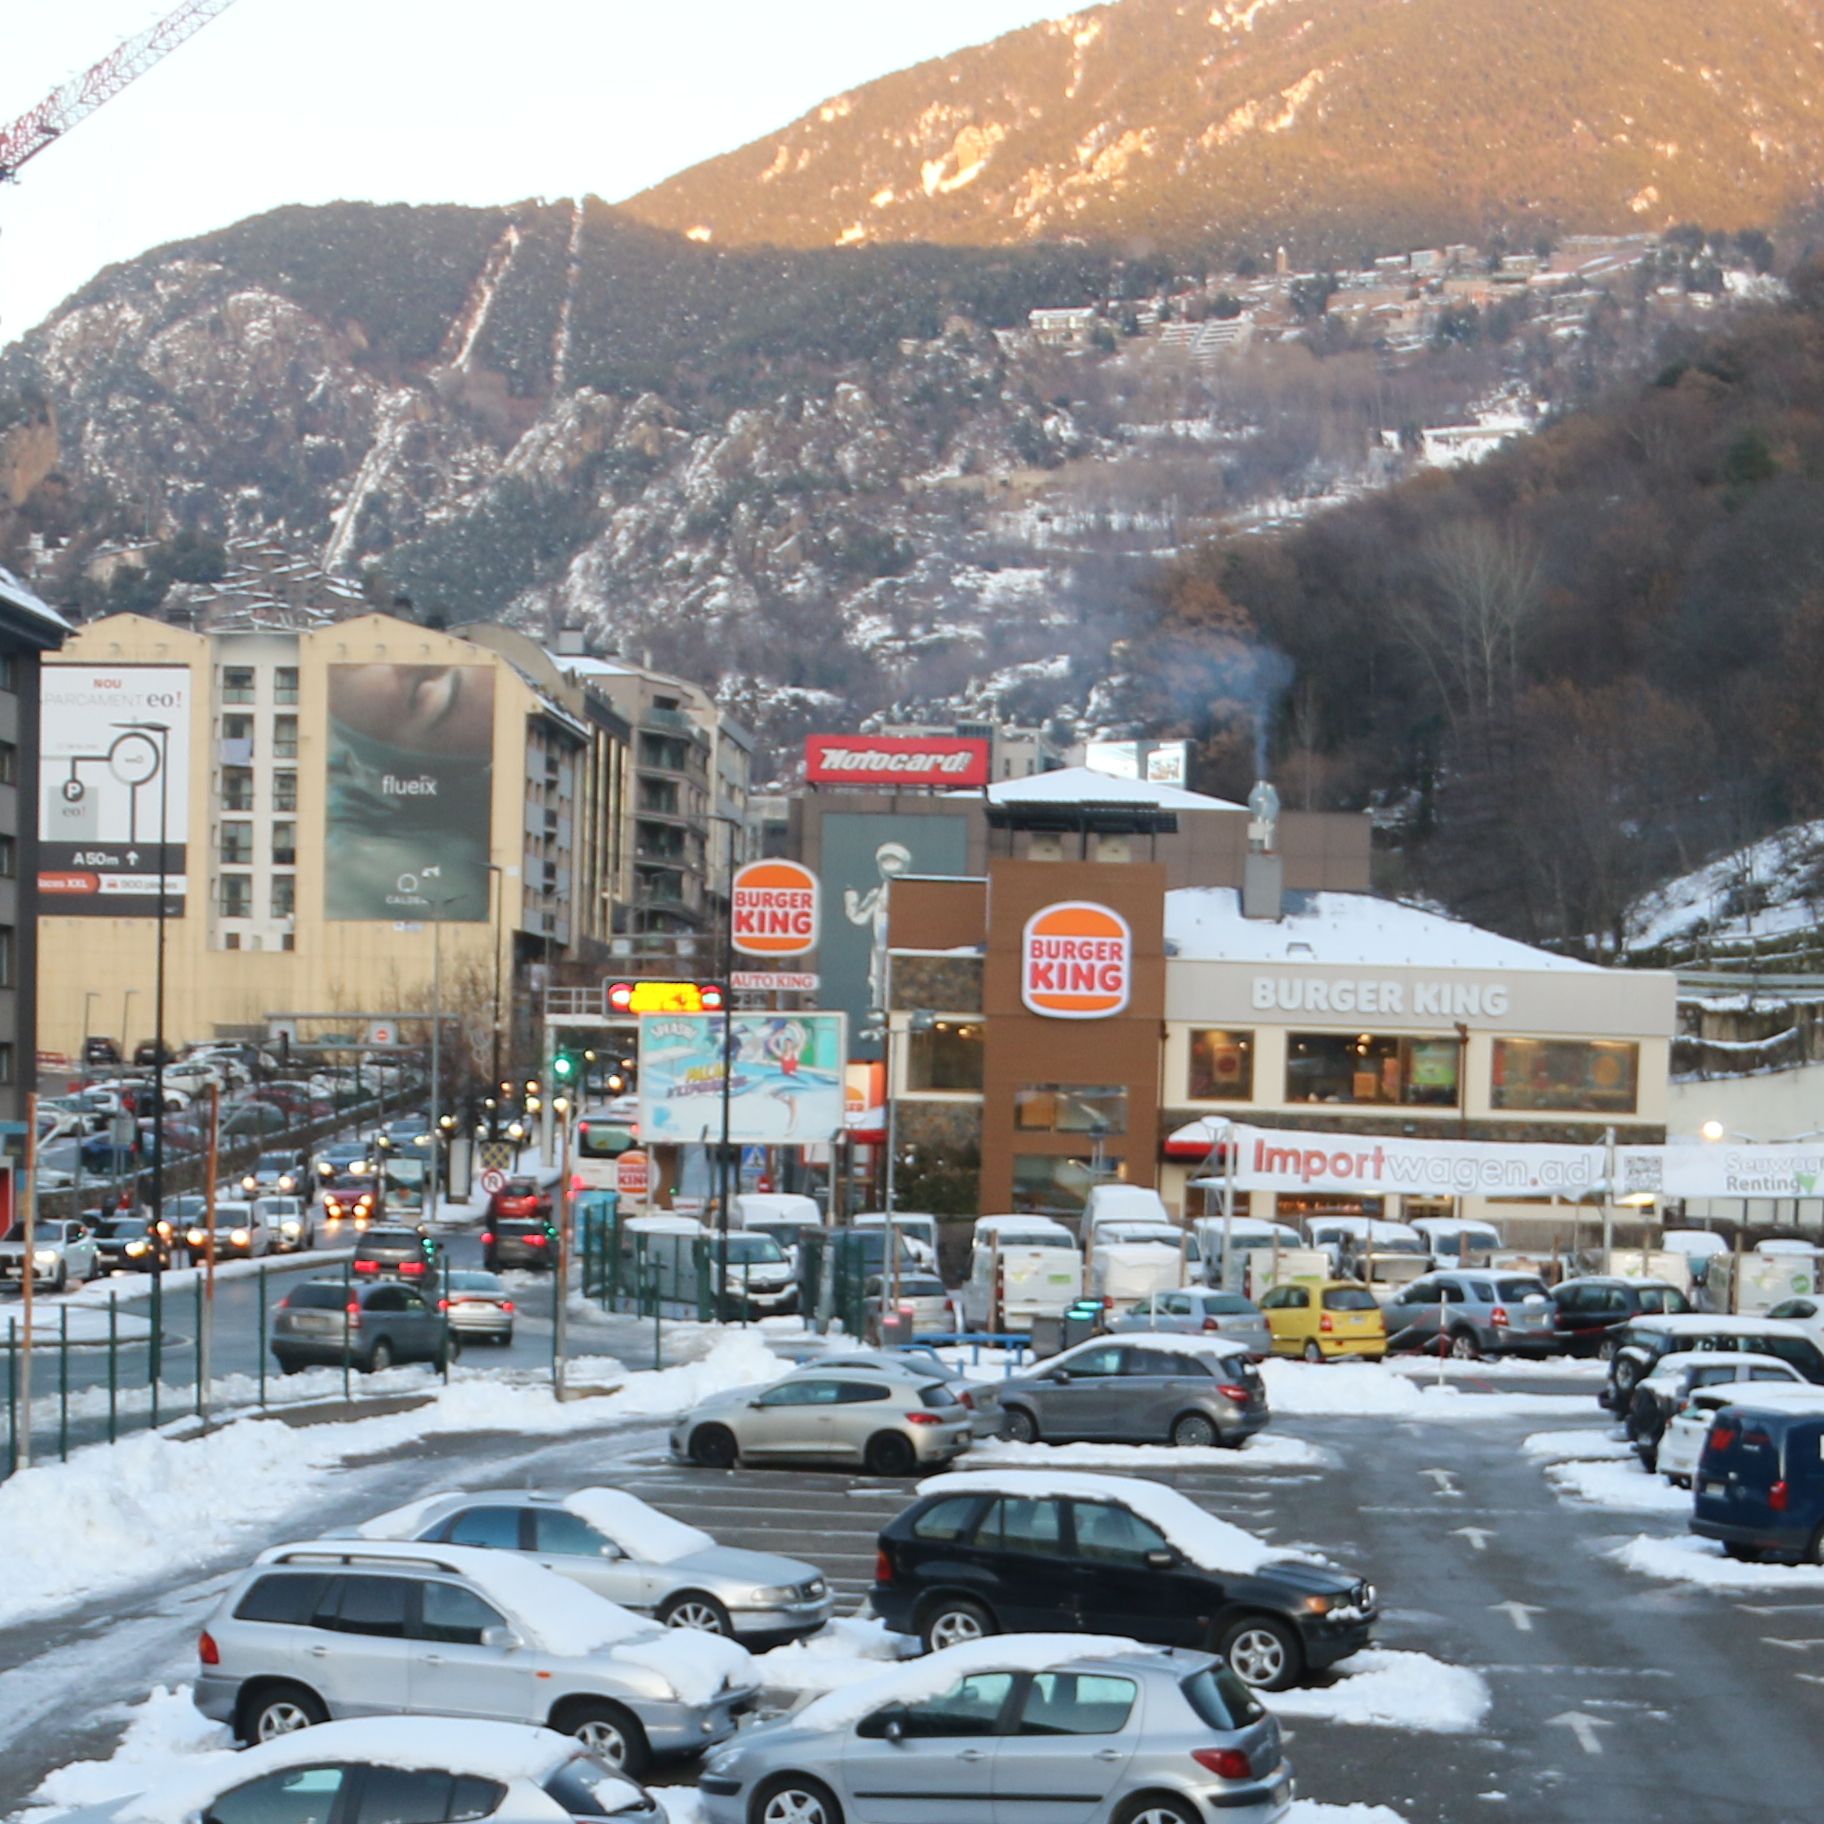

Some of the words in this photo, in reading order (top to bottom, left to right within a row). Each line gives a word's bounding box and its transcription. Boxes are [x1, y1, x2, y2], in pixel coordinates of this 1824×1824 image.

[93, 679, 122, 689] NOU
[40, 692, 143, 707] PARCAMENT
[146, 691, 182, 708] eo!
[735, 891, 813, 909] BURGER
[735, 910, 813, 935] KING
[1031, 940, 1123, 961] BURGER
[731, 975, 773, 988] AUTO
[776, 975, 814, 989] KING
[1030, 961, 1123, 992] KING
[1251, 977, 1406, 1014] BURGER
[1412, 982, 1509, 1017] KING
[1253, 1138, 1591, 1193] Importwagen.ad
[1725, 1175, 1801, 1193] Renting
